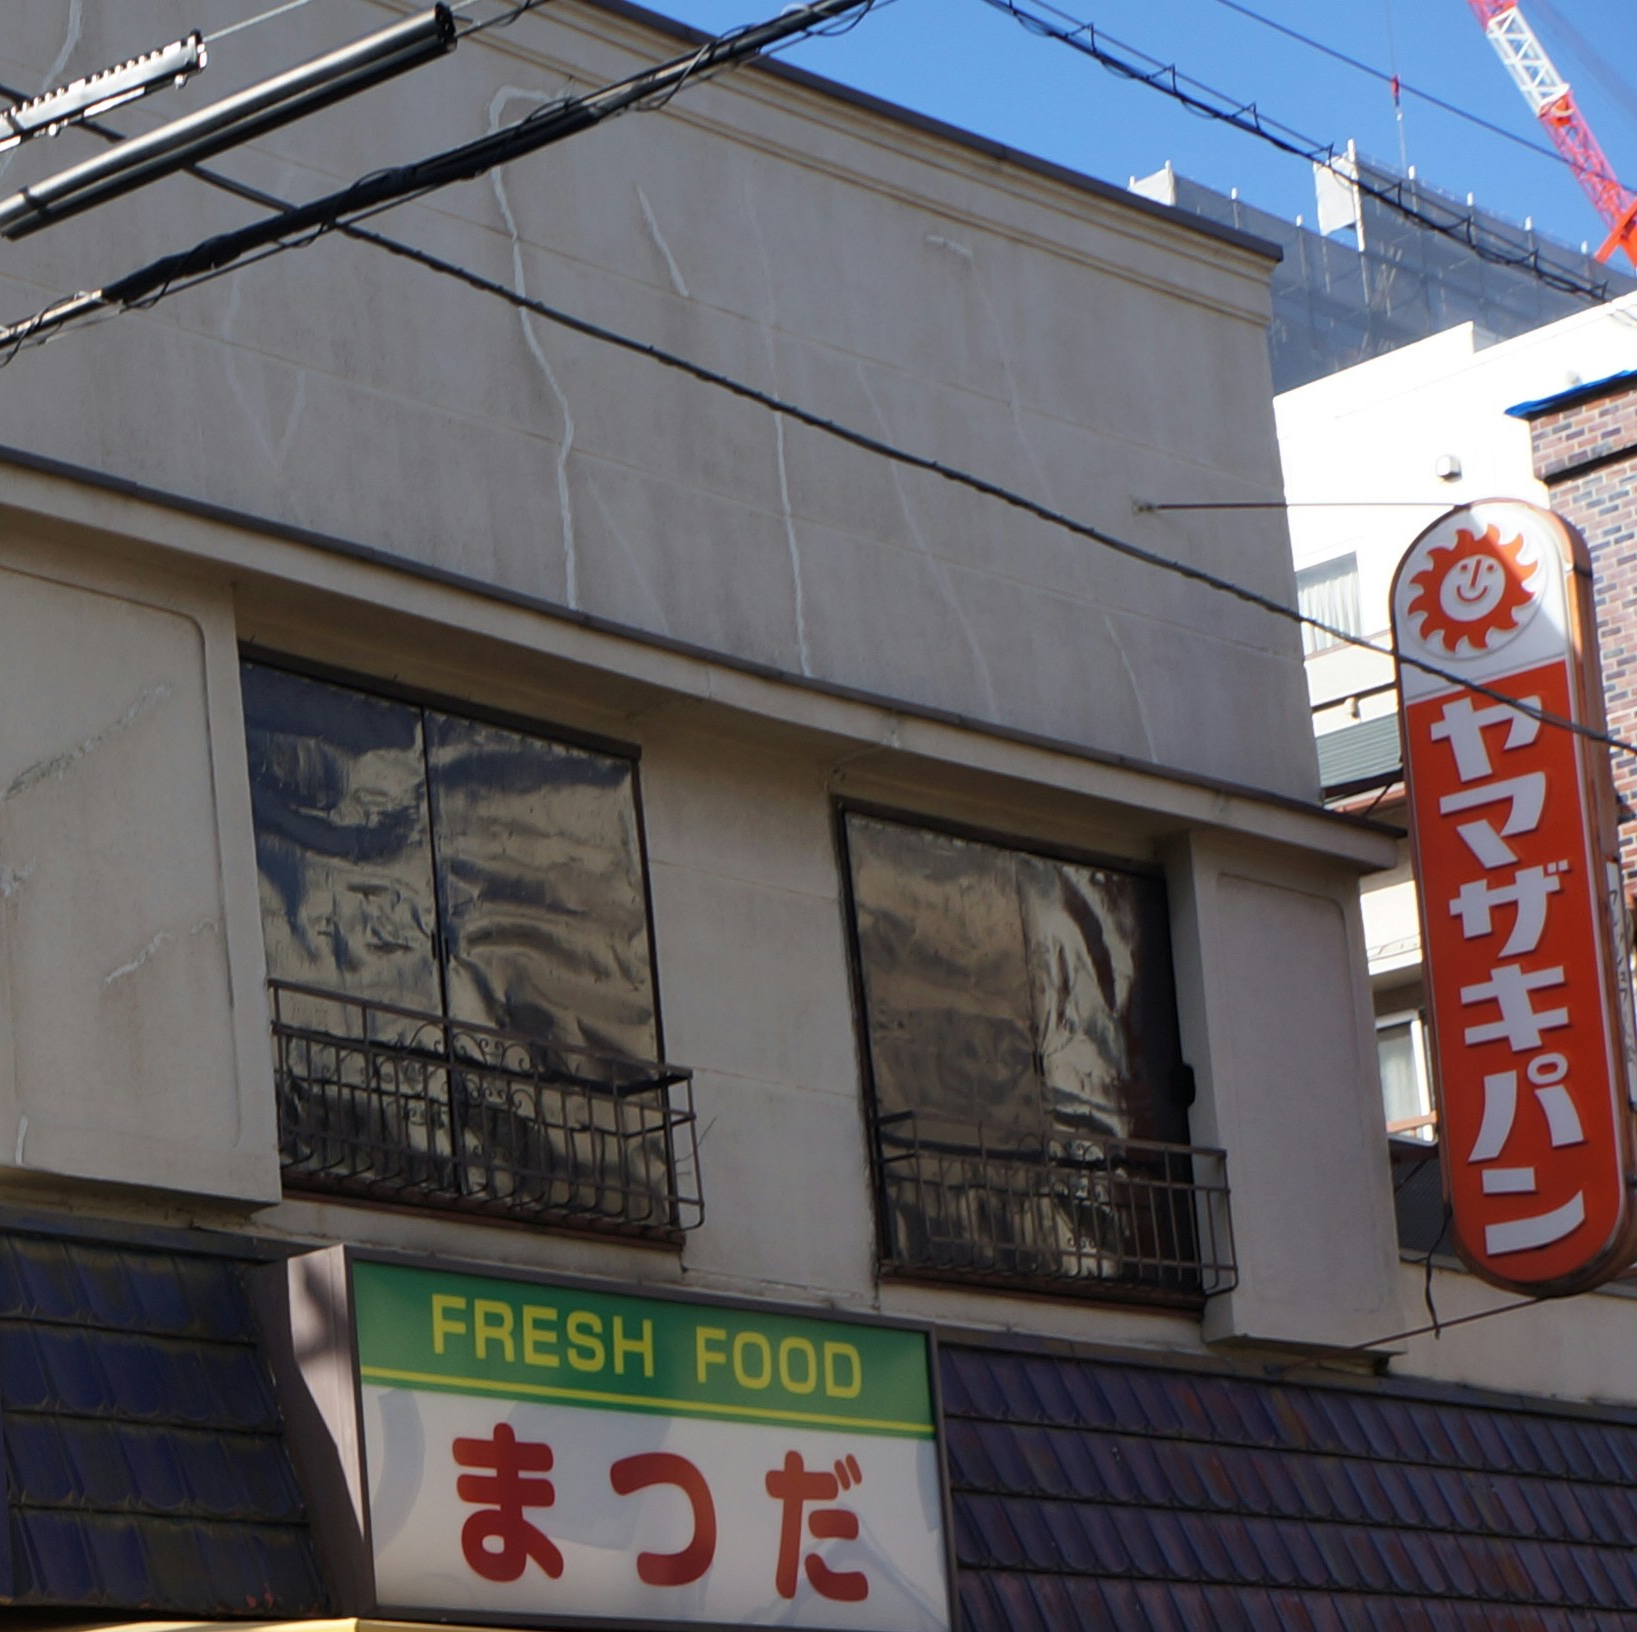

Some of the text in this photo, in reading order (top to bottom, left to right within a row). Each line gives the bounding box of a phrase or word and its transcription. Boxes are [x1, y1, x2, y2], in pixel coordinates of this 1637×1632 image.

[1429, 694, 1590, 1256] ヤマザキパン
[431, 1294, 863, 1400] FRESH FOOD
[451, 1422, 869, 1602] まつだ
